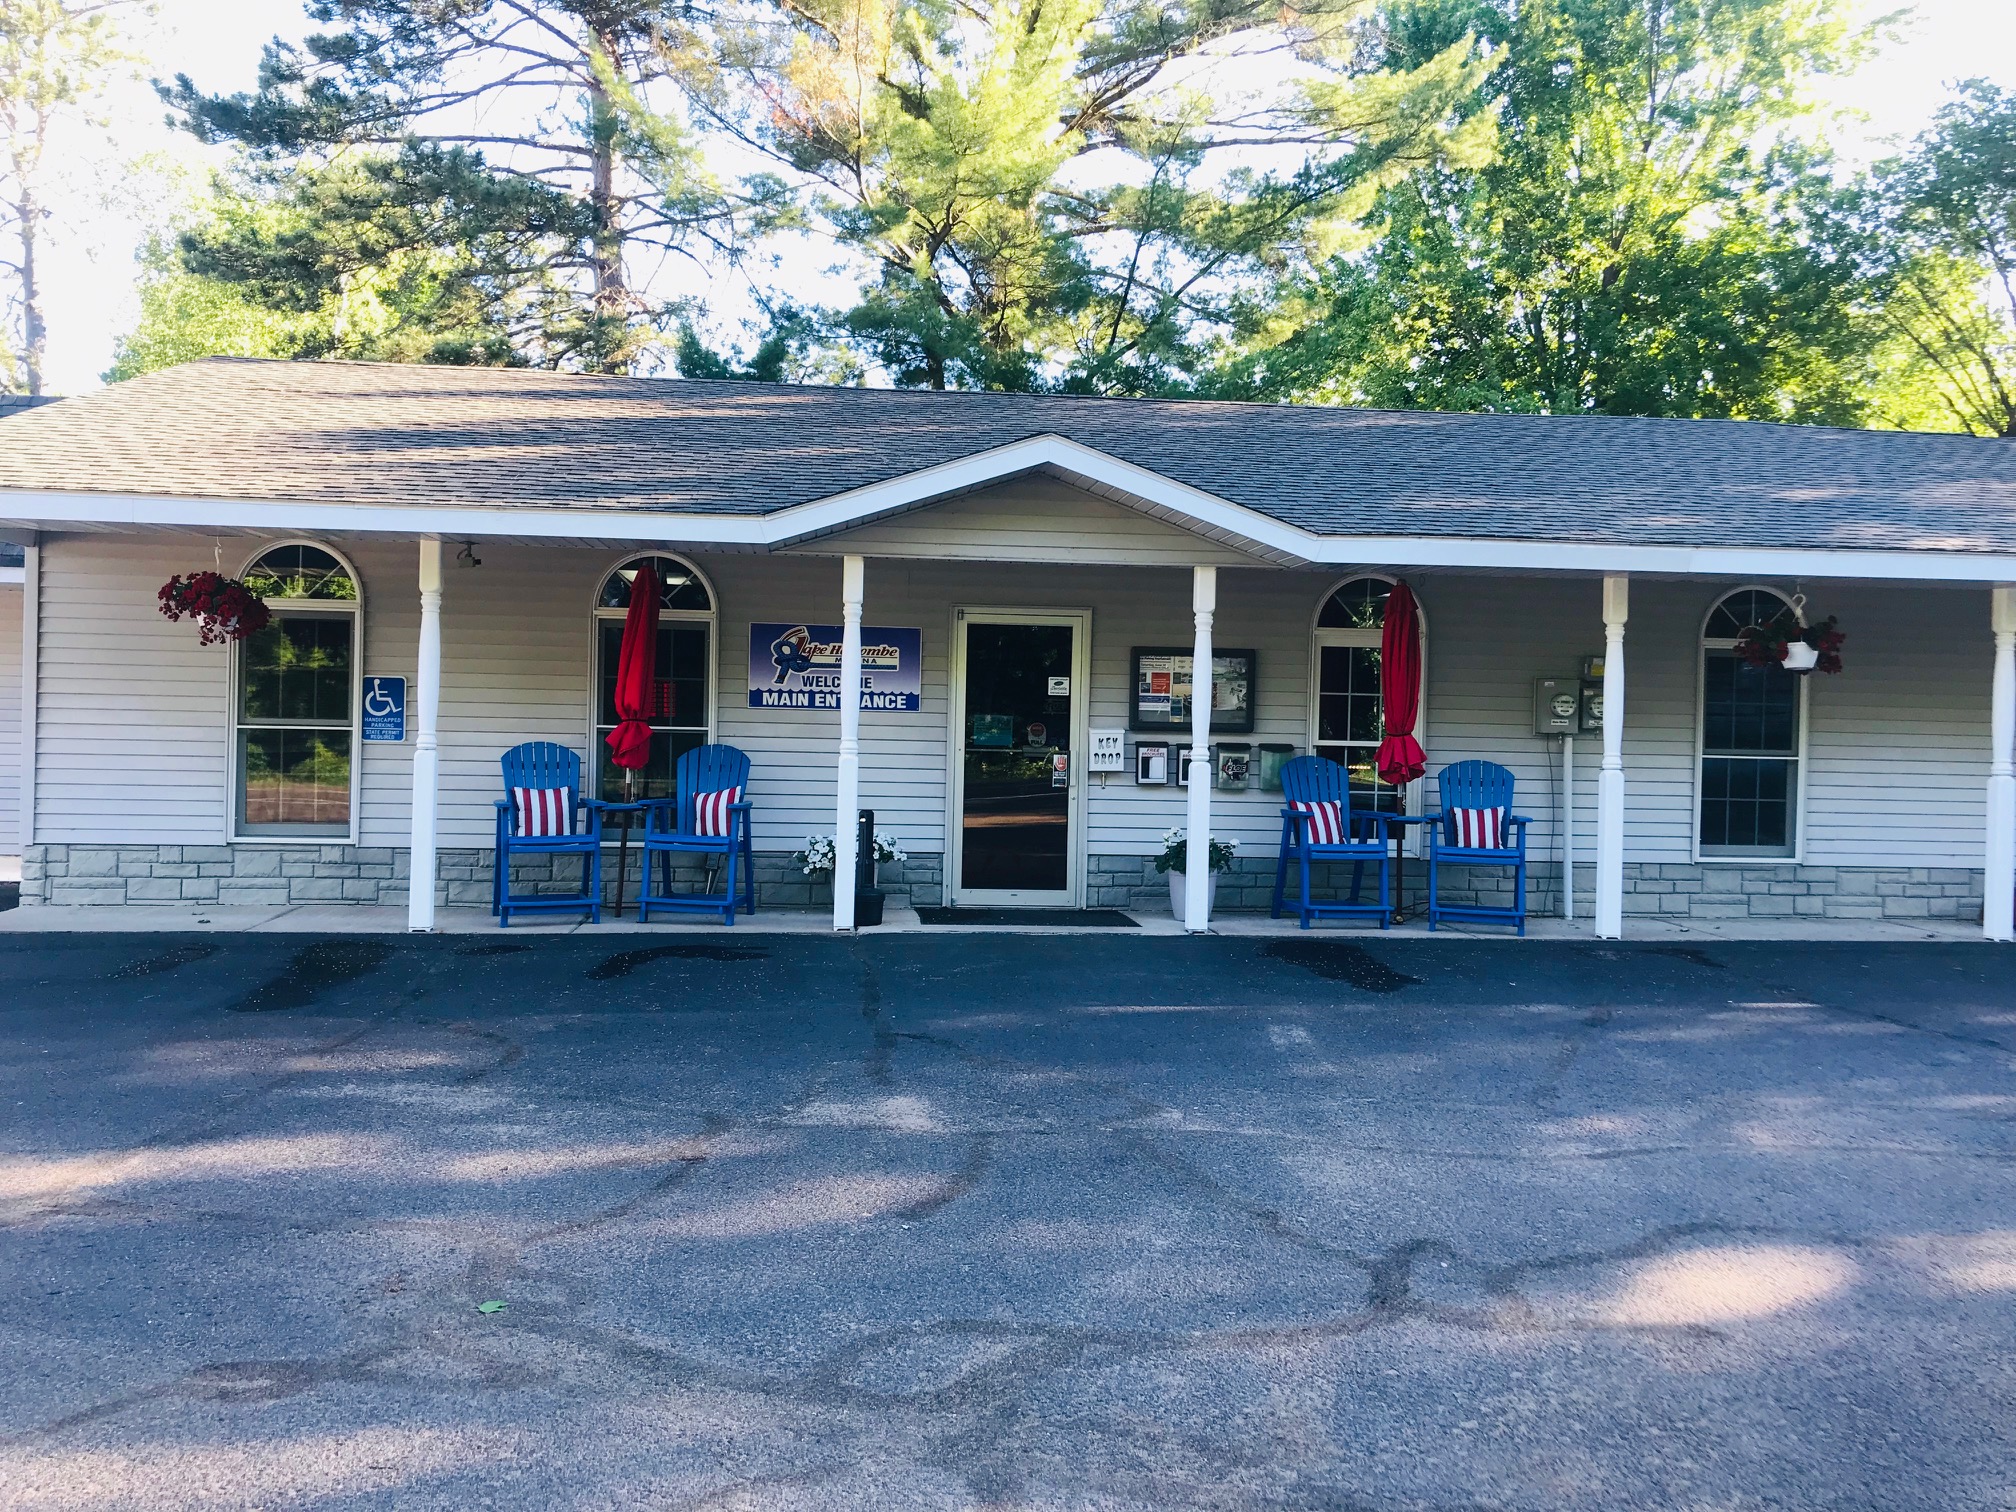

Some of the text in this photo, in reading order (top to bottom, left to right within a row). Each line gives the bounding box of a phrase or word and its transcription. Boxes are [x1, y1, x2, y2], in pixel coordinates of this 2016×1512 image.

[830, 645, 898, 656] Hombe
[802, 676, 872, 689] WELCE
[763, 693, 809, 706] MAIN
[1098, 738, 1118, 749] KEY
[1094, 753, 1121, 764] DROP
